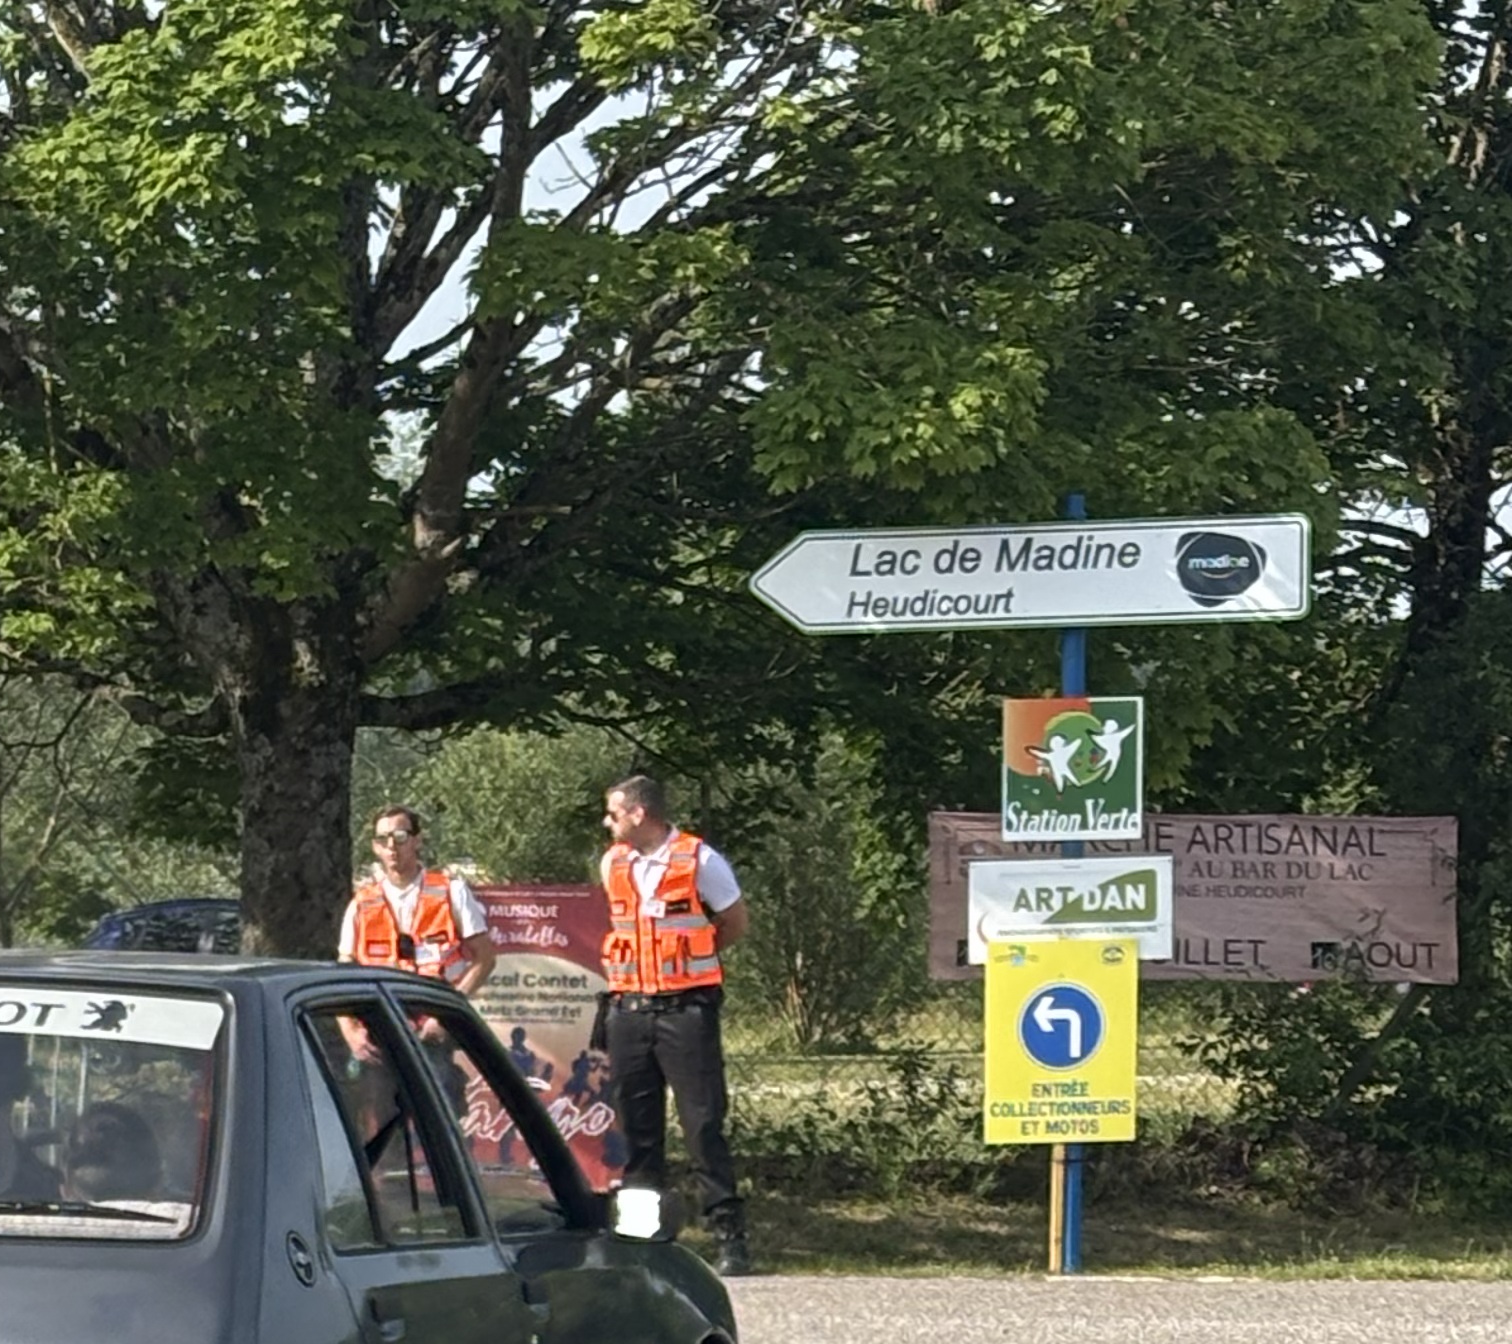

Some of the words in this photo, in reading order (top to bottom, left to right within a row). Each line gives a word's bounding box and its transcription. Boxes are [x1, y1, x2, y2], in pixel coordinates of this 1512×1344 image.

[848, 542, 921, 577] Lac
[933, 539, 981, 574] de
[995, 534, 1142, 574] Madine
[846, 586, 1015, 619] Heudicourt
[1007, 801, 1082, 833] Station
[1085, 798, 1140, 832] Verte
[1186, 822, 1387, 857] ARTISANAL
[1189, 860, 1224, 879] AU
[1231, 861, 1277, 880] BAR
[1285, 861, 1322, 880] DU
[1328, 862, 1375, 881] LAC
[1012, 886, 1075, 914] ART
[1080, 883, 1146, 911] DAN
[1205, 885, 1306, 899] HEUDICOURT
[489, 904, 559, 918] MUSIQUE
[1344, 940, 1440, 969] AOUT
[1031, 1078, 1090, 1099] ENTRÉE
[990, 1100, 1132, 1118] COLLECTIONNEURS
[1021, 1120, 1040, 1136] ET
[1045, 1119, 1100, 1136] MOTOS
